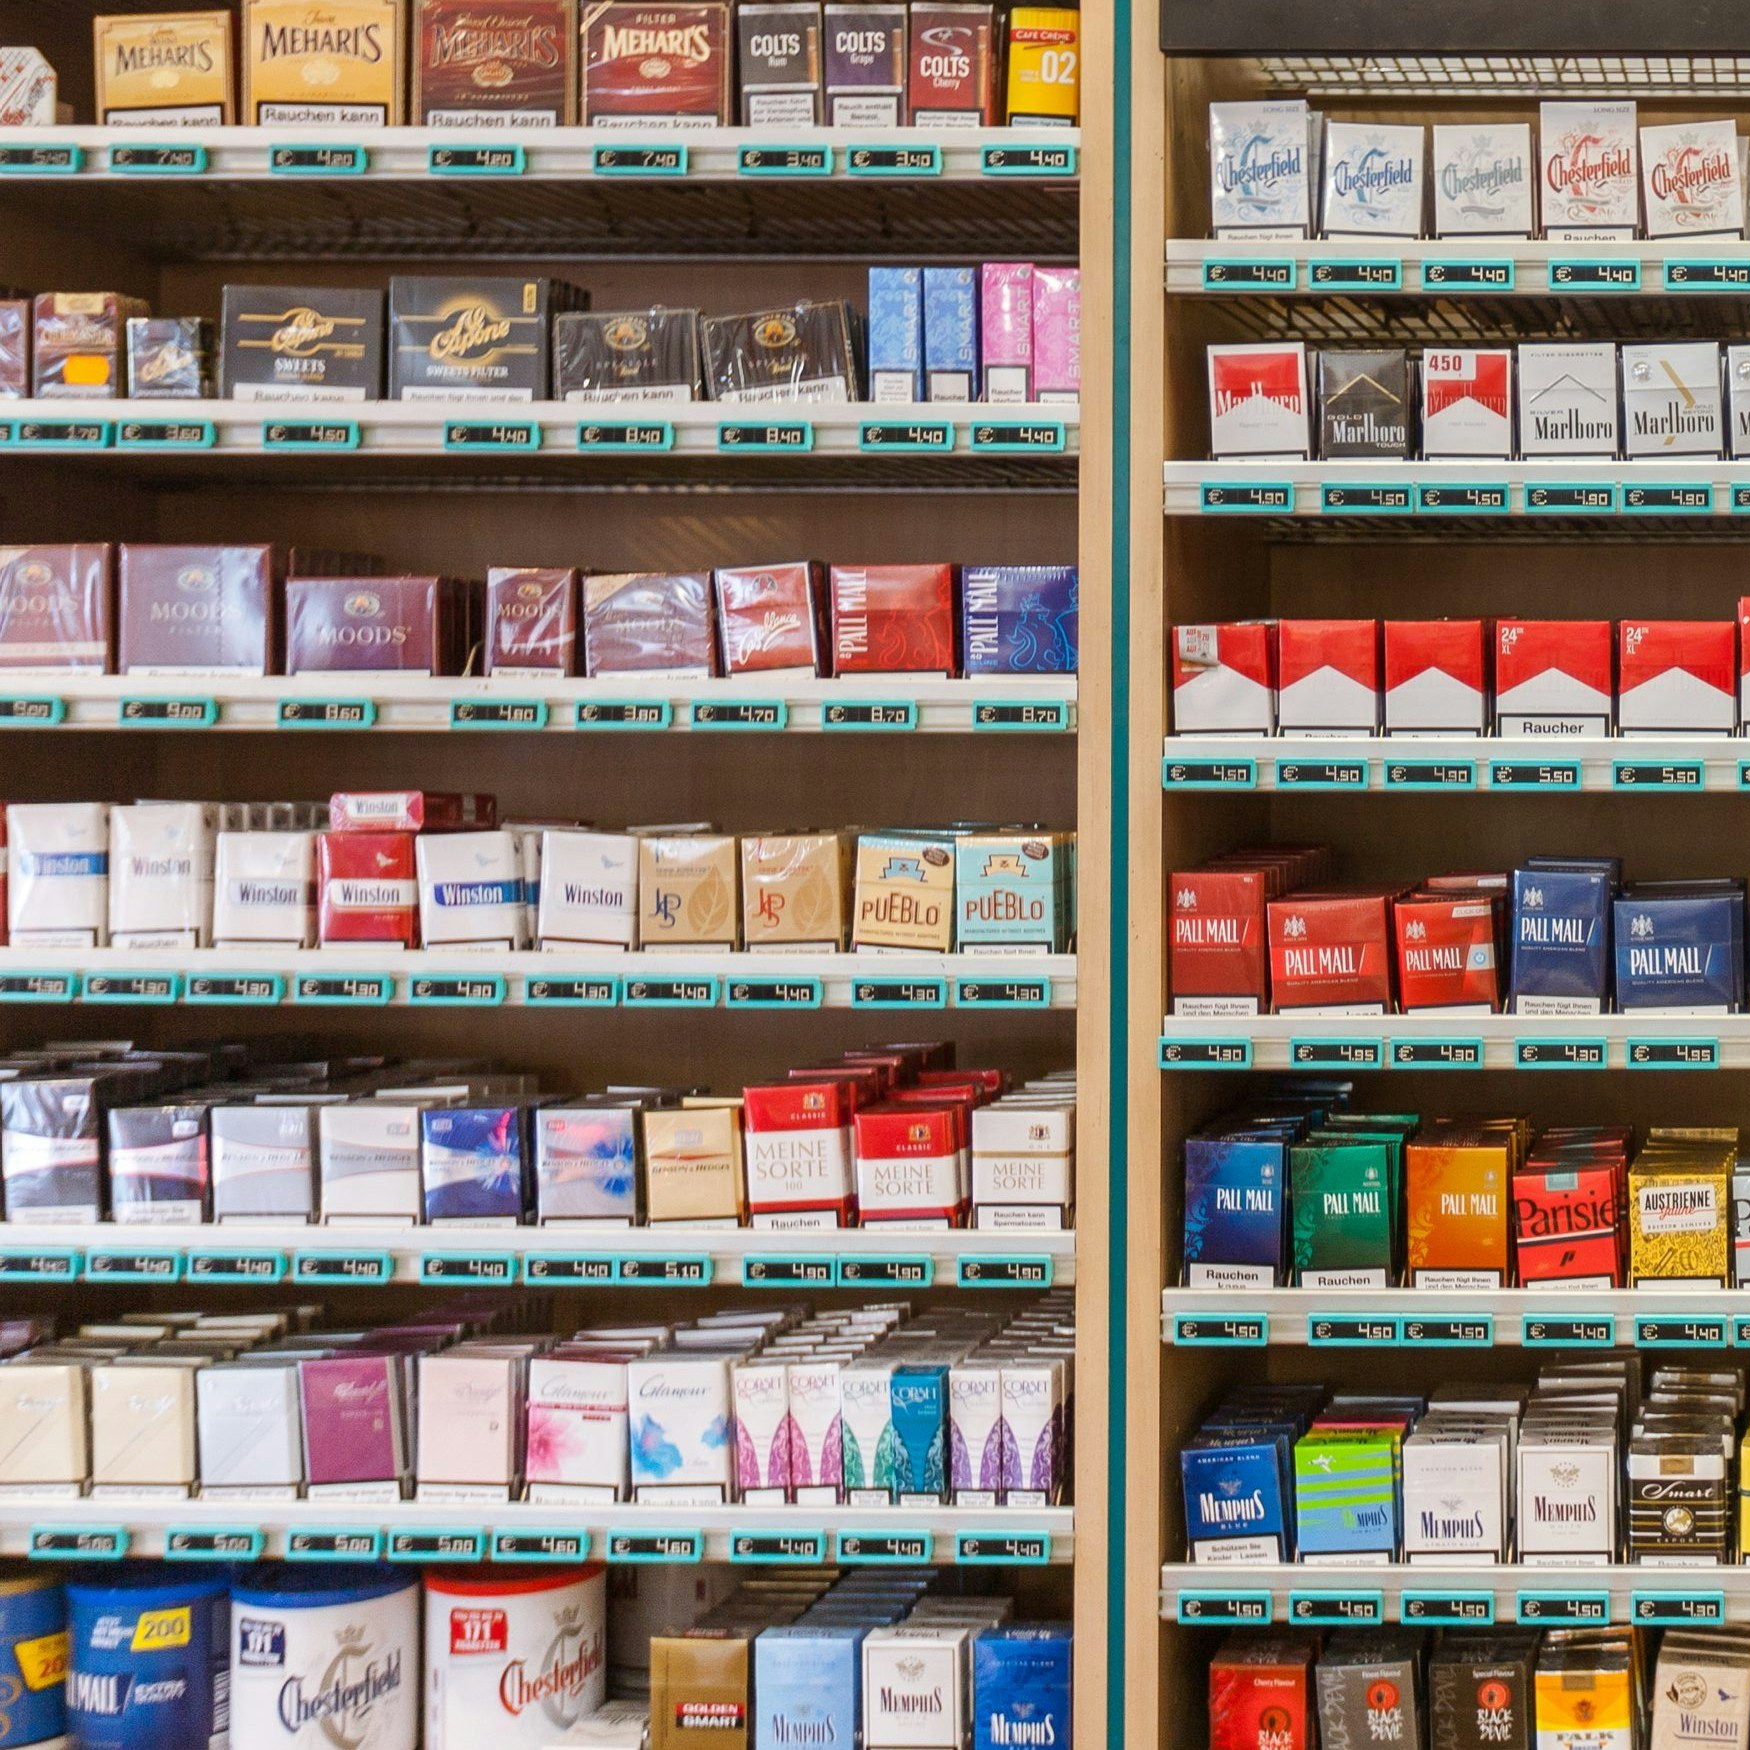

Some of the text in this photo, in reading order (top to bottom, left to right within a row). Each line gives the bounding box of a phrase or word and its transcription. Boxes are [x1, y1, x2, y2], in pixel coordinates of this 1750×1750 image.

[636, 13, 676, 25] FILTER
[260, 23, 383, 64] MEHARI'S
[603, 24, 711, 61] MEHARI'S
[750, 34, 800, 57] COLTS
[115, 38, 214, 76] MEHARI'S
[920, 55, 970, 78] COLTS
[1041, 51, 1076, 84] 02
[932, 76, 960, 90] Cherry
[265, 107, 380, 125] Rauchen kann
[988, 150, 1065, 168] € 4.40
[1217, 146, 1300, 192] Chesterfield
[1548, 146, 1632, 193] Chesterfield
[1334, 155, 1412, 194] Chesterfield
[1210, 265, 1286, 282] € 4.40
[1428, 354, 1463, 372] 450
[1332, 412, 1406, 444] Marlboro
[1534, 408, 1613, 440] Marlboro
[1633, 401, 1716, 436] Marlboro
[1501, 627, 1518, 644] 24
[1626, 627, 1643, 644] 24
[1522, 722, 1584, 736] Raucher
[1496, 765, 1573, 783] € 5.50
[341, 883, 400, 904] Winston
[564, 883, 623, 908] Winston
[861, 893, 940, 926] PUEBLO
[1176, 920, 1240, 944] PALL MALL
[1520, 918, 1584, 944] PALL MALL
[1284, 948, 1356, 976] PALL MALL
[859, 984, 875, 1001] €
[790, 1110, 827, 1120] CLASSIC
[755, 1139, 828, 1163] MEINE
[755, 1160, 829, 1179] SORTE
[874, 1164, 933, 1182] MEINE
[874, 1179, 935, 1196] SORTE
[1216, 1188, 1274, 1212] PALL MALL
[1324, 1192, 1380, 1214] PALL MALL
[1645, 1190, 1710, 1211] AUSTRIENNE
[965, 1263, 1042, 1280] € 4.90
[1206, 1270, 1259, 1282] Rauchen
[1642, 1481, 1713, 1499] Smart
[1199, 1490, 1264, 1522] MEMPHIS
[1421, 1509, 1483, 1540] MEMPHIS
[144, 1617, 183, 1638] 200
[681, 1704, 739, 1714] GOLDEN
[880, 1686, 942, 1714] MEMPHIS
[684, 1716, 741, 1728] SMART
[1367, 1708, 1402, 1726] BLACK
[1680, 1712, 1738, 1736] Winston
[990, 1715, 1055, 1746] MEMPHIS
[1370, 1724, 1402, 1742] DEVIL
